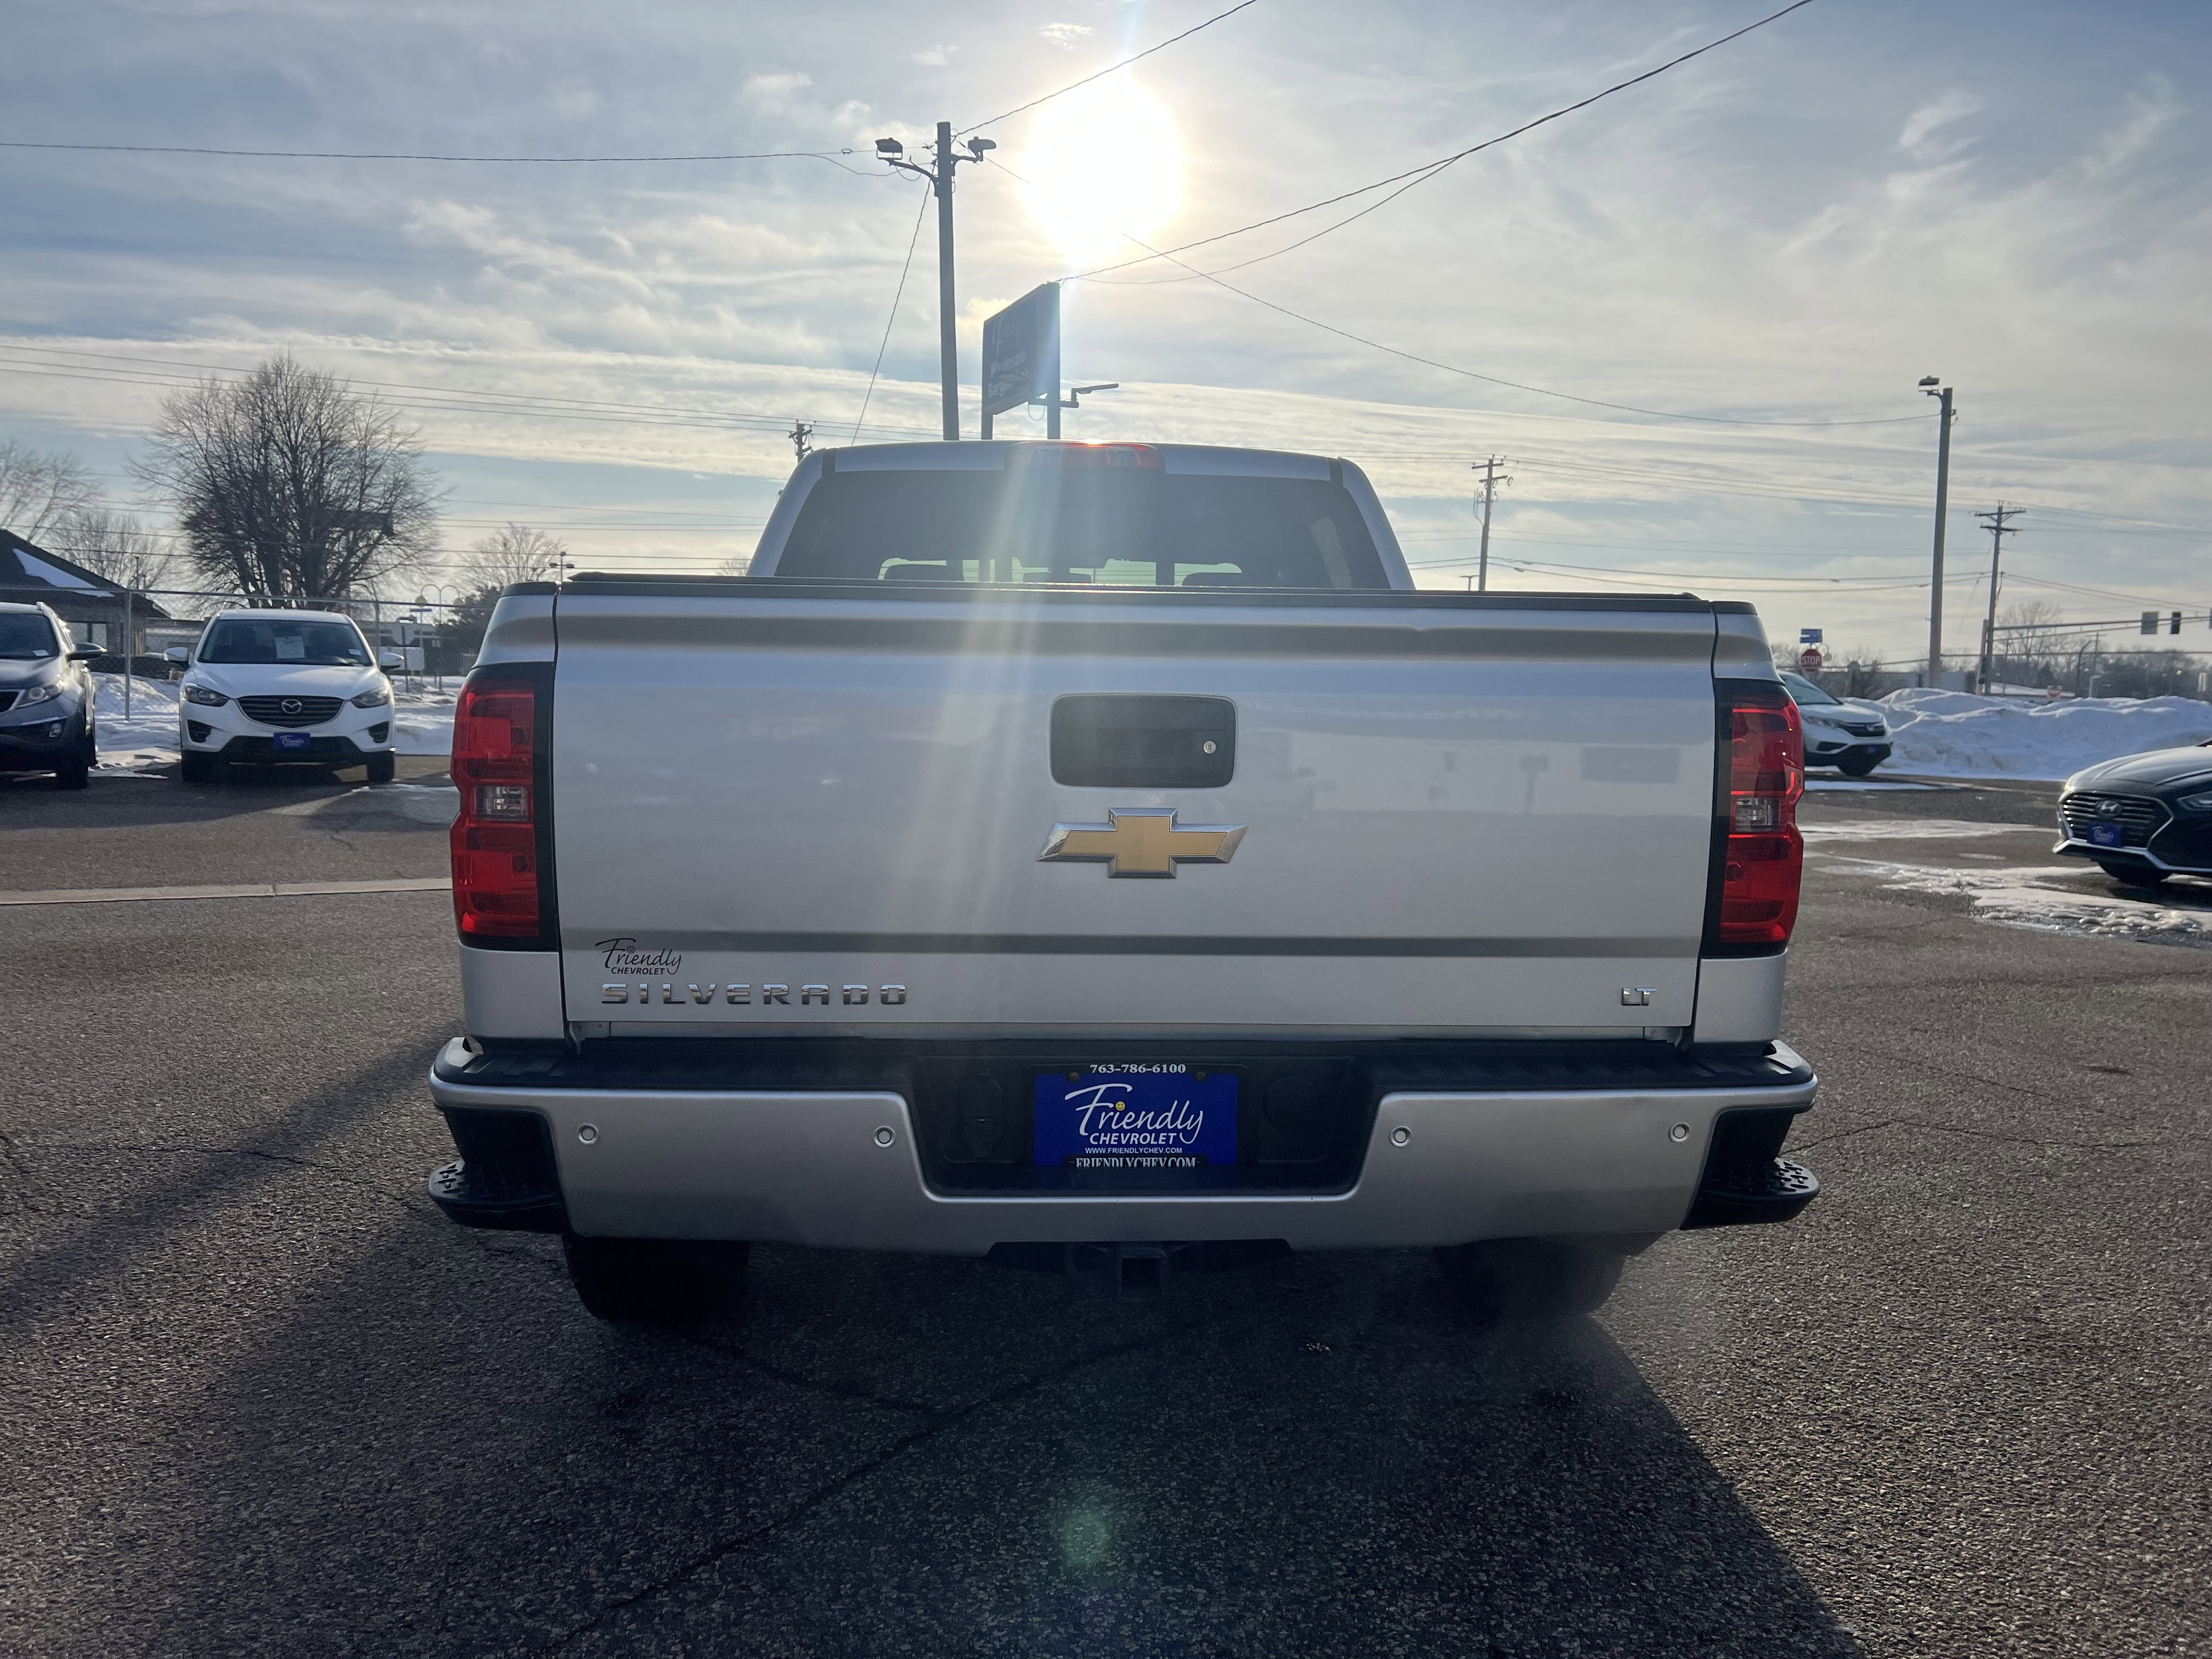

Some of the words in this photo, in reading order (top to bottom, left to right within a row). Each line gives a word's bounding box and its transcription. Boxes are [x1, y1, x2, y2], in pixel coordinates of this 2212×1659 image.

[1802, 655, 1821, 665] STOP
[595, 938, 681, 975] Friendly
[611, 967, 665, 975] CHEVROLET
[602, 983, 907, 1005] SILVERADO
[1622, 987, 1657, 1006] LT
[1089, 1064, 1186, 1074] 763-786-6100
[1064, 1083, 1203, 1144] Friendly
[1089, 1132, 1177, 1145] CHEVROLET
[1075, 1157, 1197, 1168] FRIENDLYCHEVCOM
